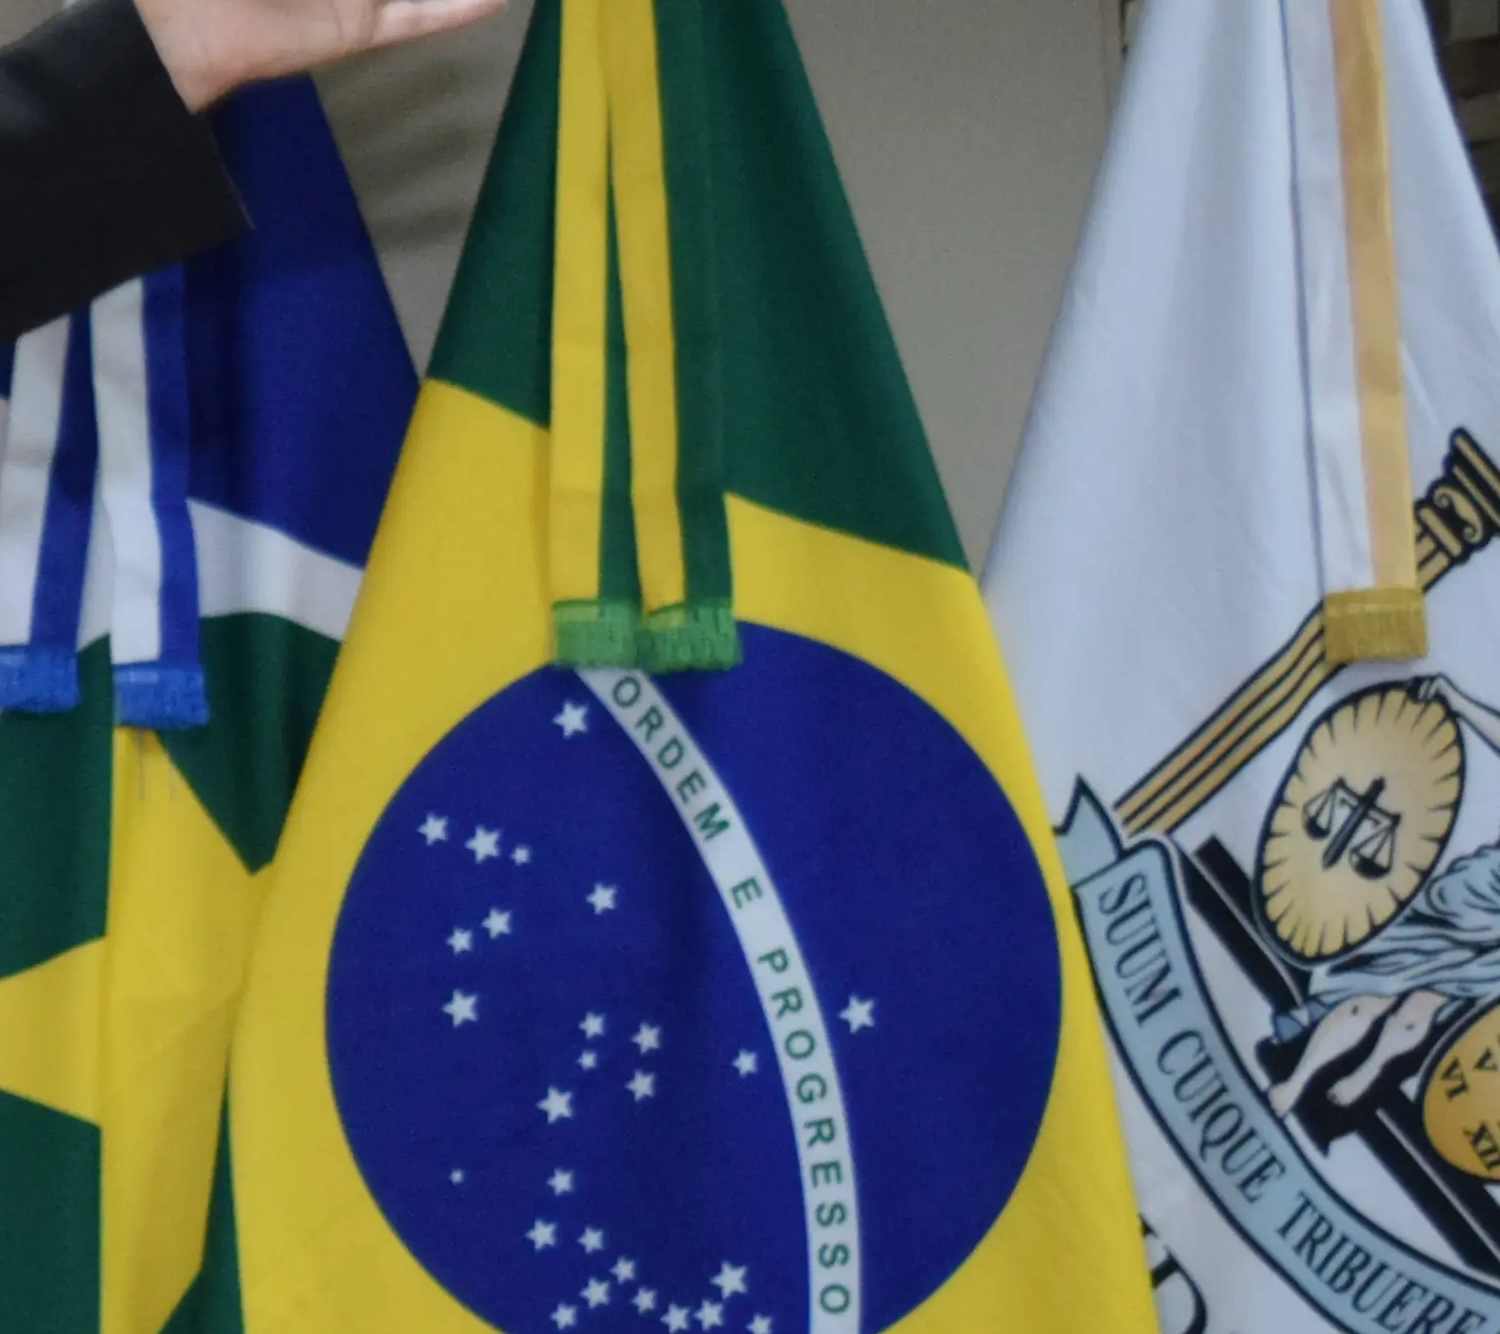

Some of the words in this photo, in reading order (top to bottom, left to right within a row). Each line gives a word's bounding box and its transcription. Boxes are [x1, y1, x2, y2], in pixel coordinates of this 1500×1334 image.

[611, 675, 731, 842] ORDEM
[731, 876, 762, 910] E
[757, 947, 851, 1315] PROGRESSO
[1099, 872, 1182, 1027] SUUM
[1156, 1029, 1286, 1204] CUIQUE
